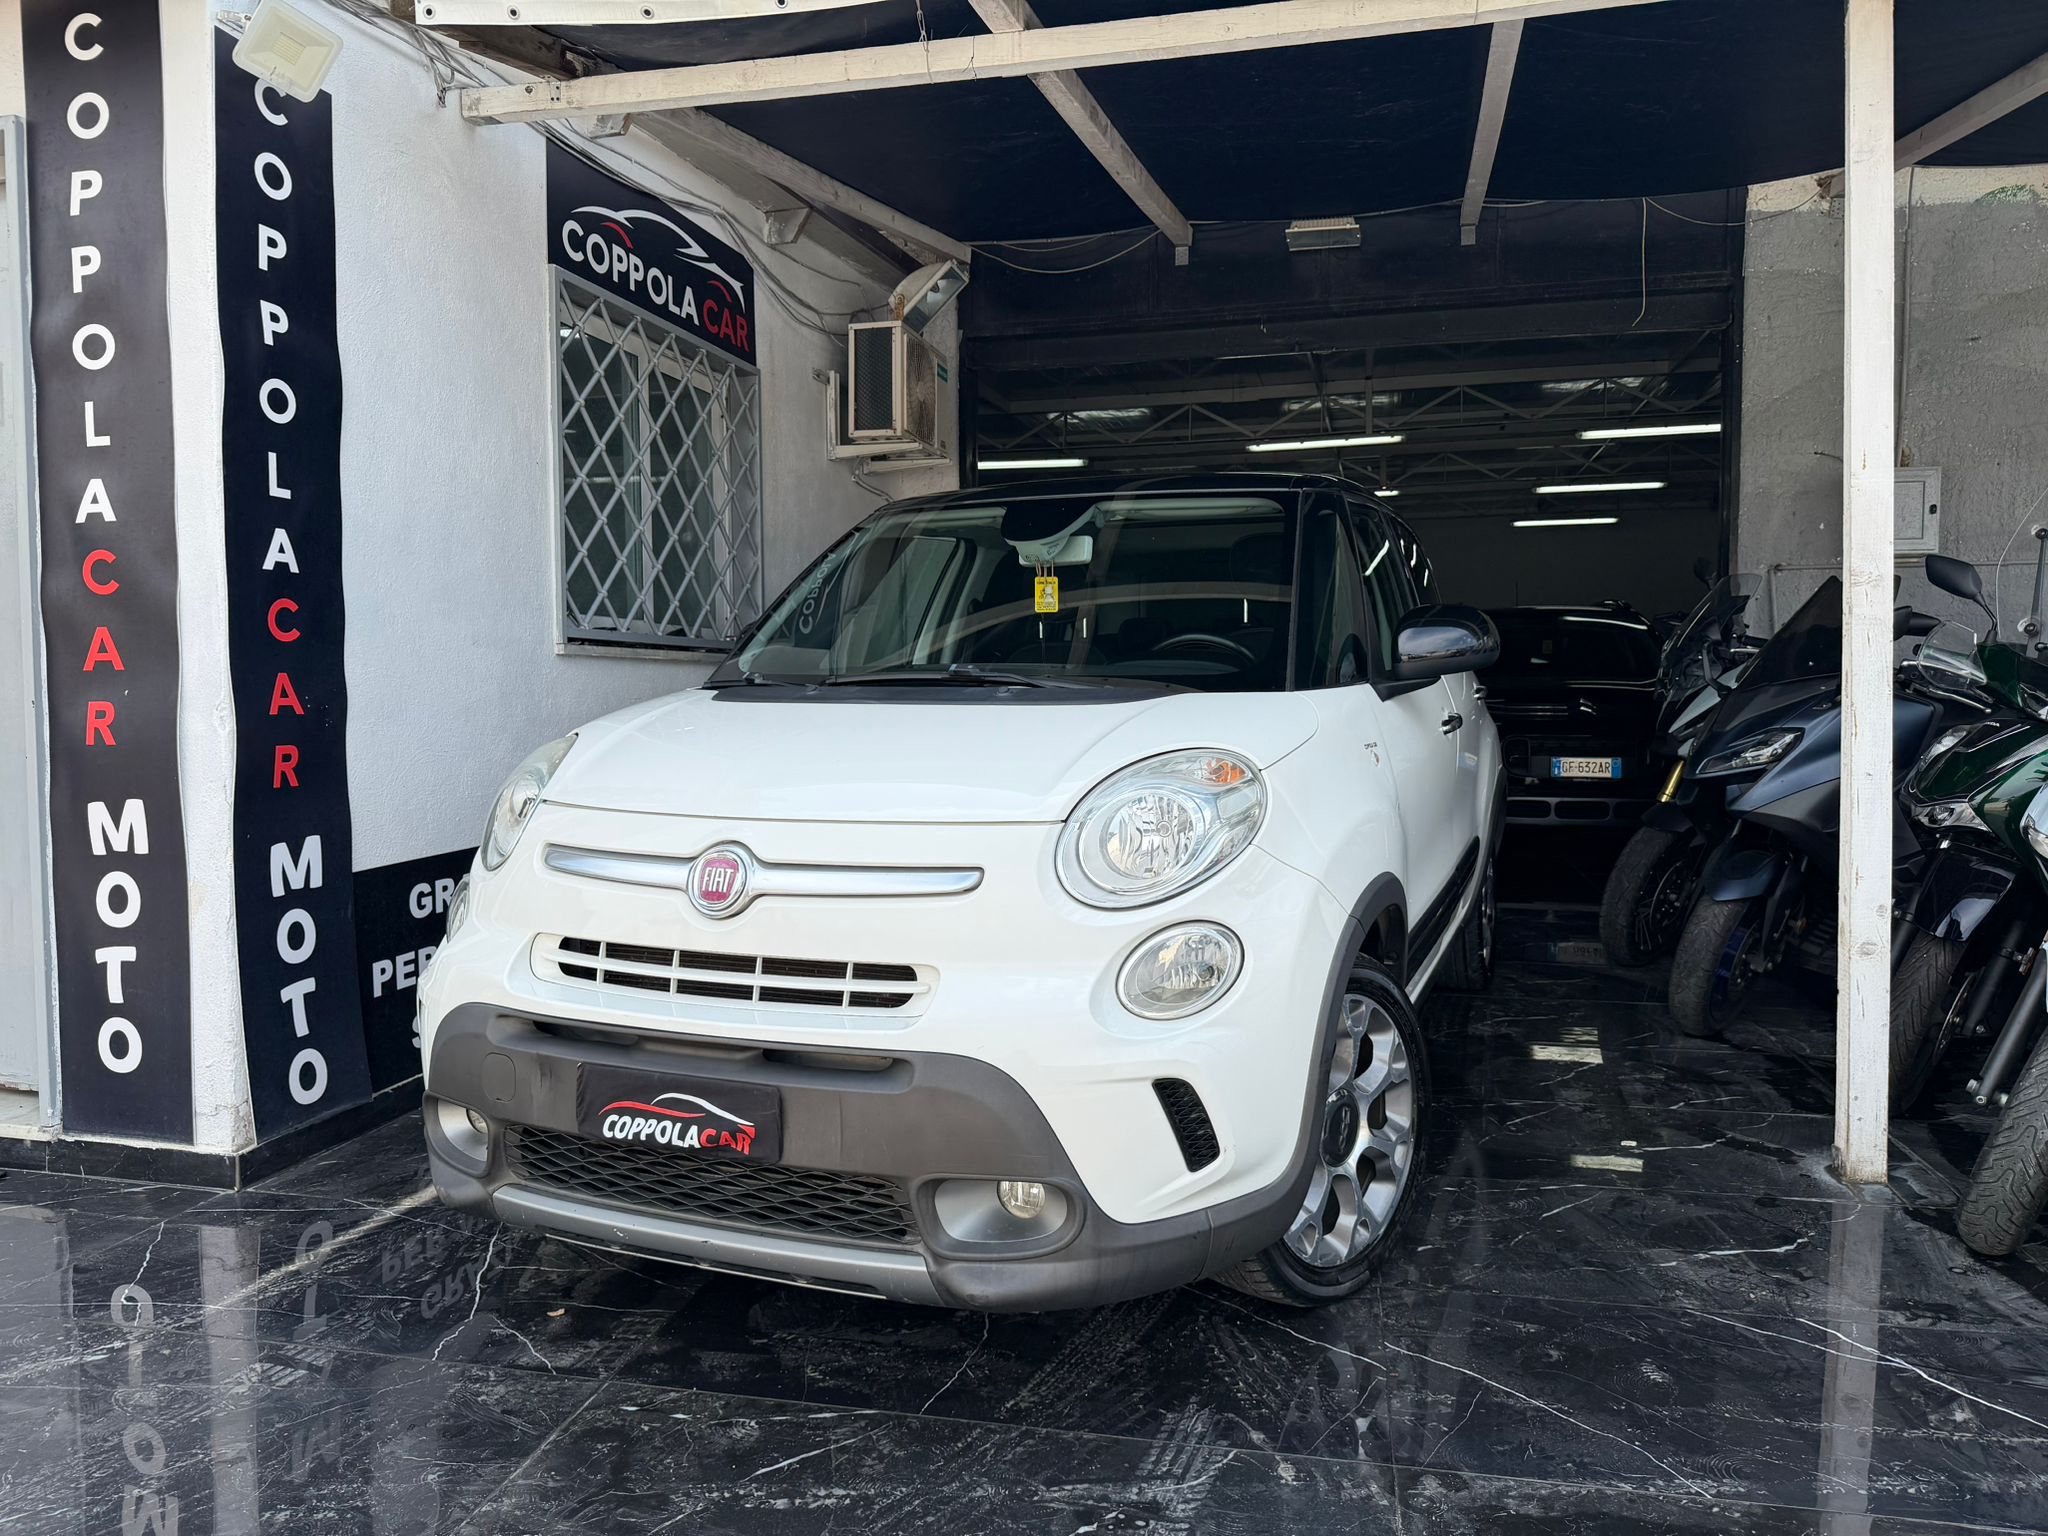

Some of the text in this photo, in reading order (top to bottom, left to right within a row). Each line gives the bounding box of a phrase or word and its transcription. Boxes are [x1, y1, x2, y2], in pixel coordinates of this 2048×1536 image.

[87, 798, 149, 1074] MOTO
[270, 835, 329, 1106] MOTO
[702, 866, 735, 893] FIAT
